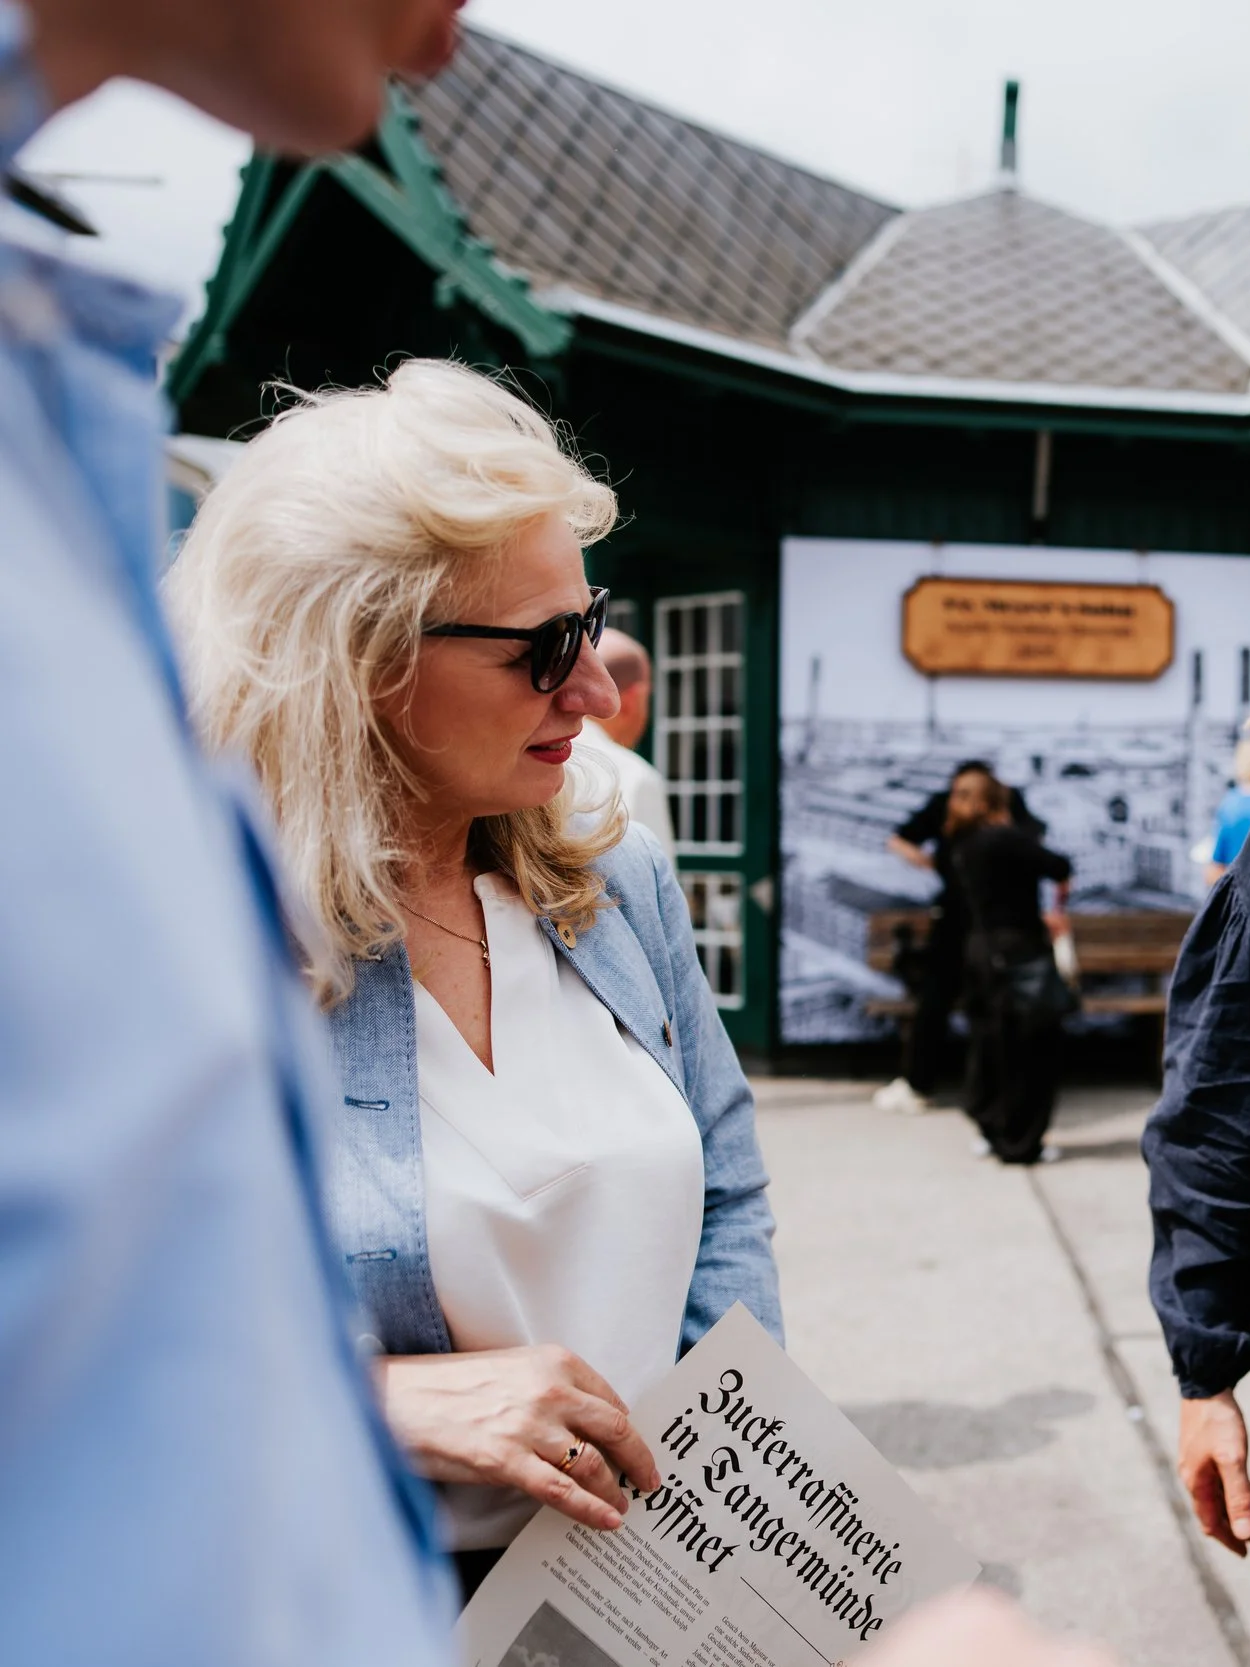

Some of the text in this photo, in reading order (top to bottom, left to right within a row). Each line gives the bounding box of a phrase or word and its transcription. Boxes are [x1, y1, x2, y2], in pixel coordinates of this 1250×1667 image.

[660, 1408, 883, 1641] in Tangermünde
[698, 1369, 902, 1585] Zuckerraffinerie
